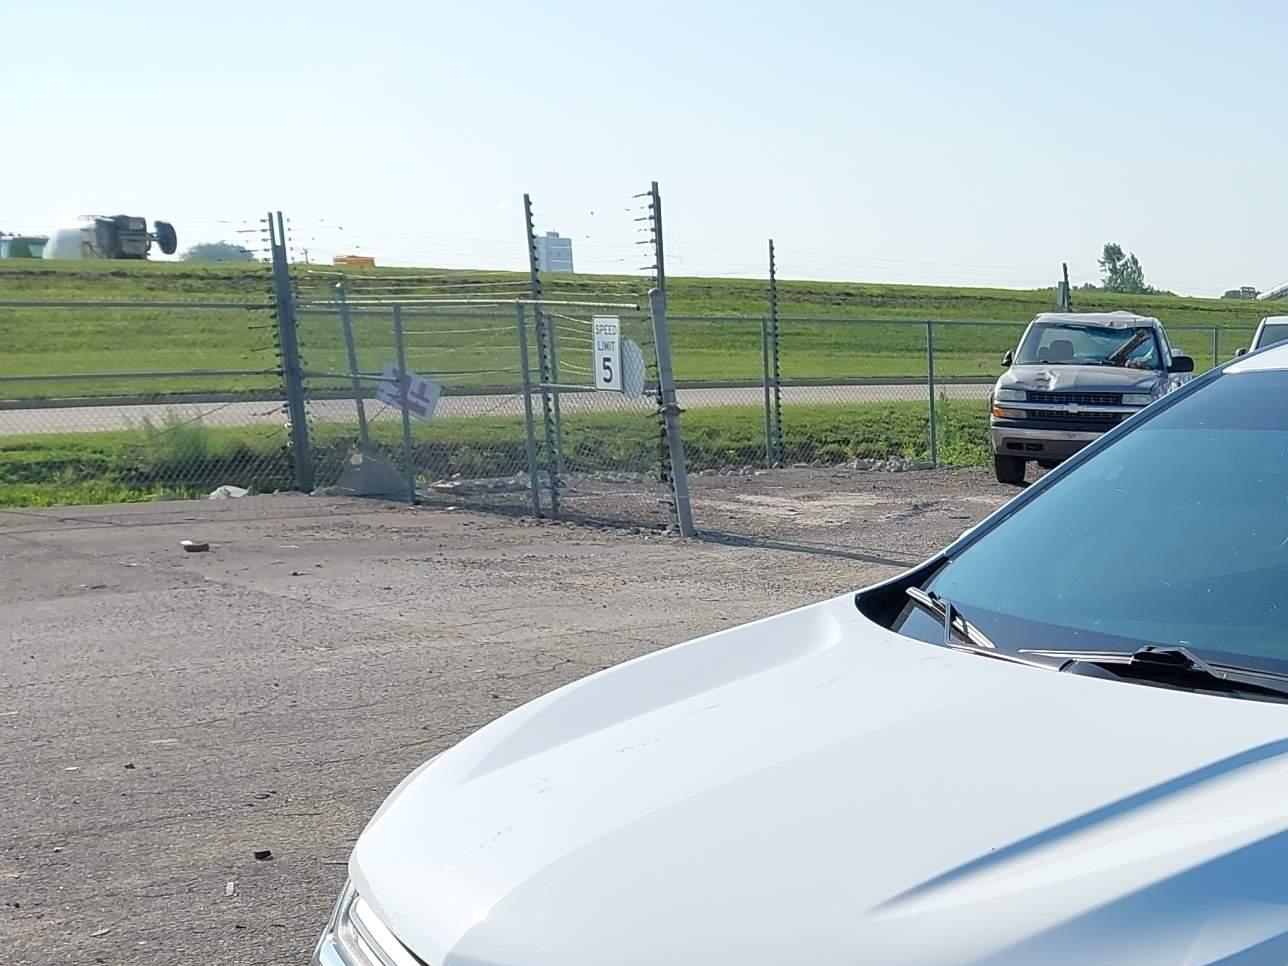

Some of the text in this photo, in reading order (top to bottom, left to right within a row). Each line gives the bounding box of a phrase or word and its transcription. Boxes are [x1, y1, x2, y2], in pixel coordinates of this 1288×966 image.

[596, 324, 617, 335] SPEED
[598, 341, 615, 352] LIMIT
[603, 357, 613, 383] 5
